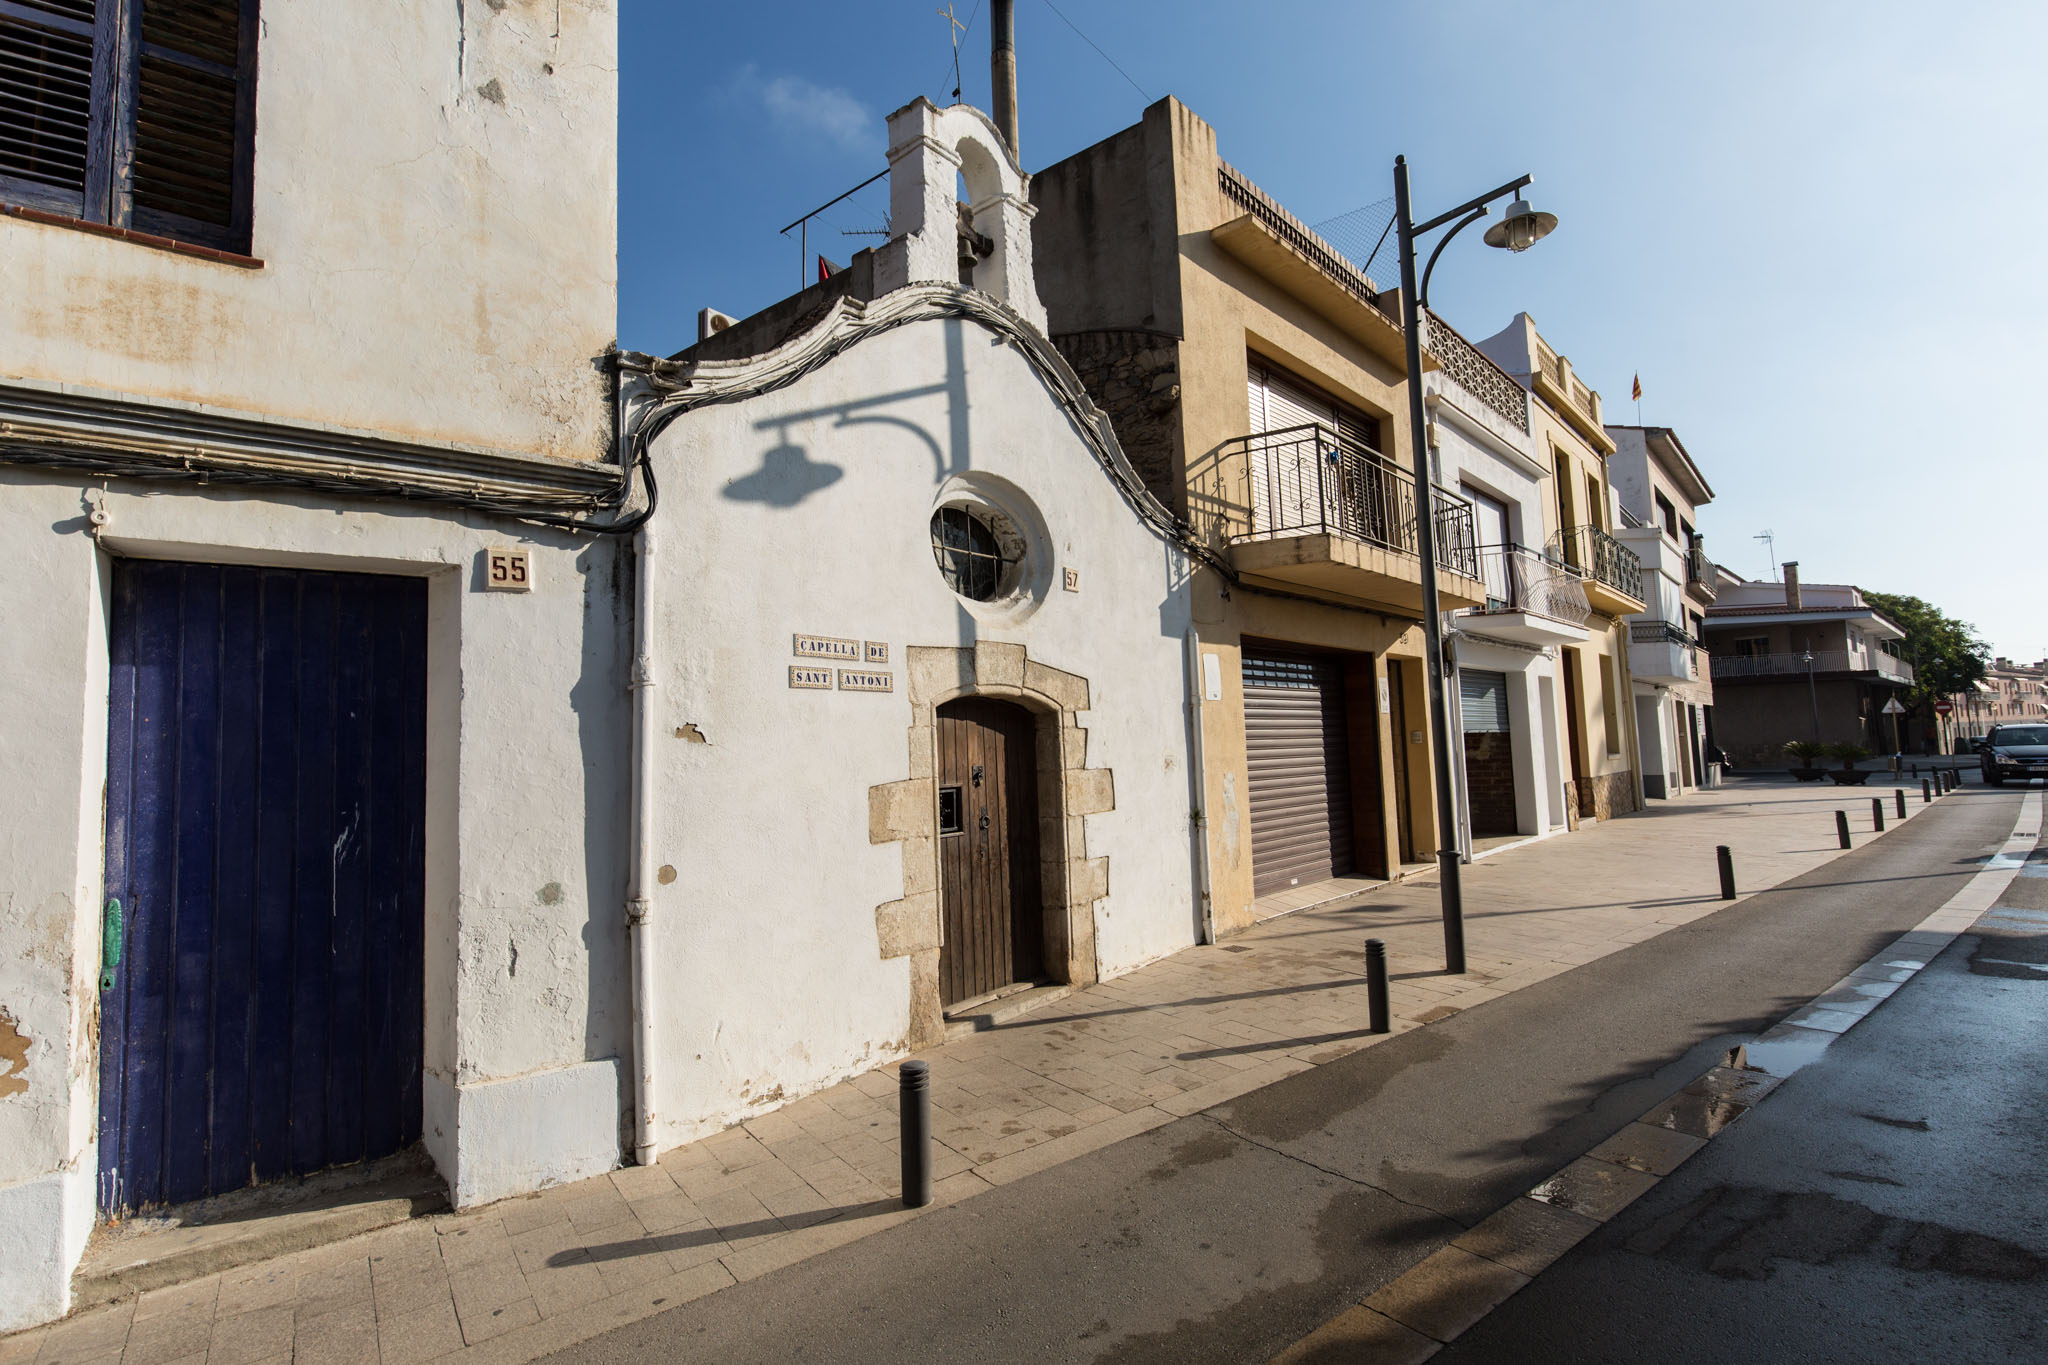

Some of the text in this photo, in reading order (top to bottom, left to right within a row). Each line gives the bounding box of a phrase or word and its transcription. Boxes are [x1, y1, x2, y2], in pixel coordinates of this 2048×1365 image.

[492, 556, 526, 582] 55
[1066, 571, 1078, 588] 57
[870, 647, 885, 658] DE
[796, 672, 888, 686] SANT ANTONI
